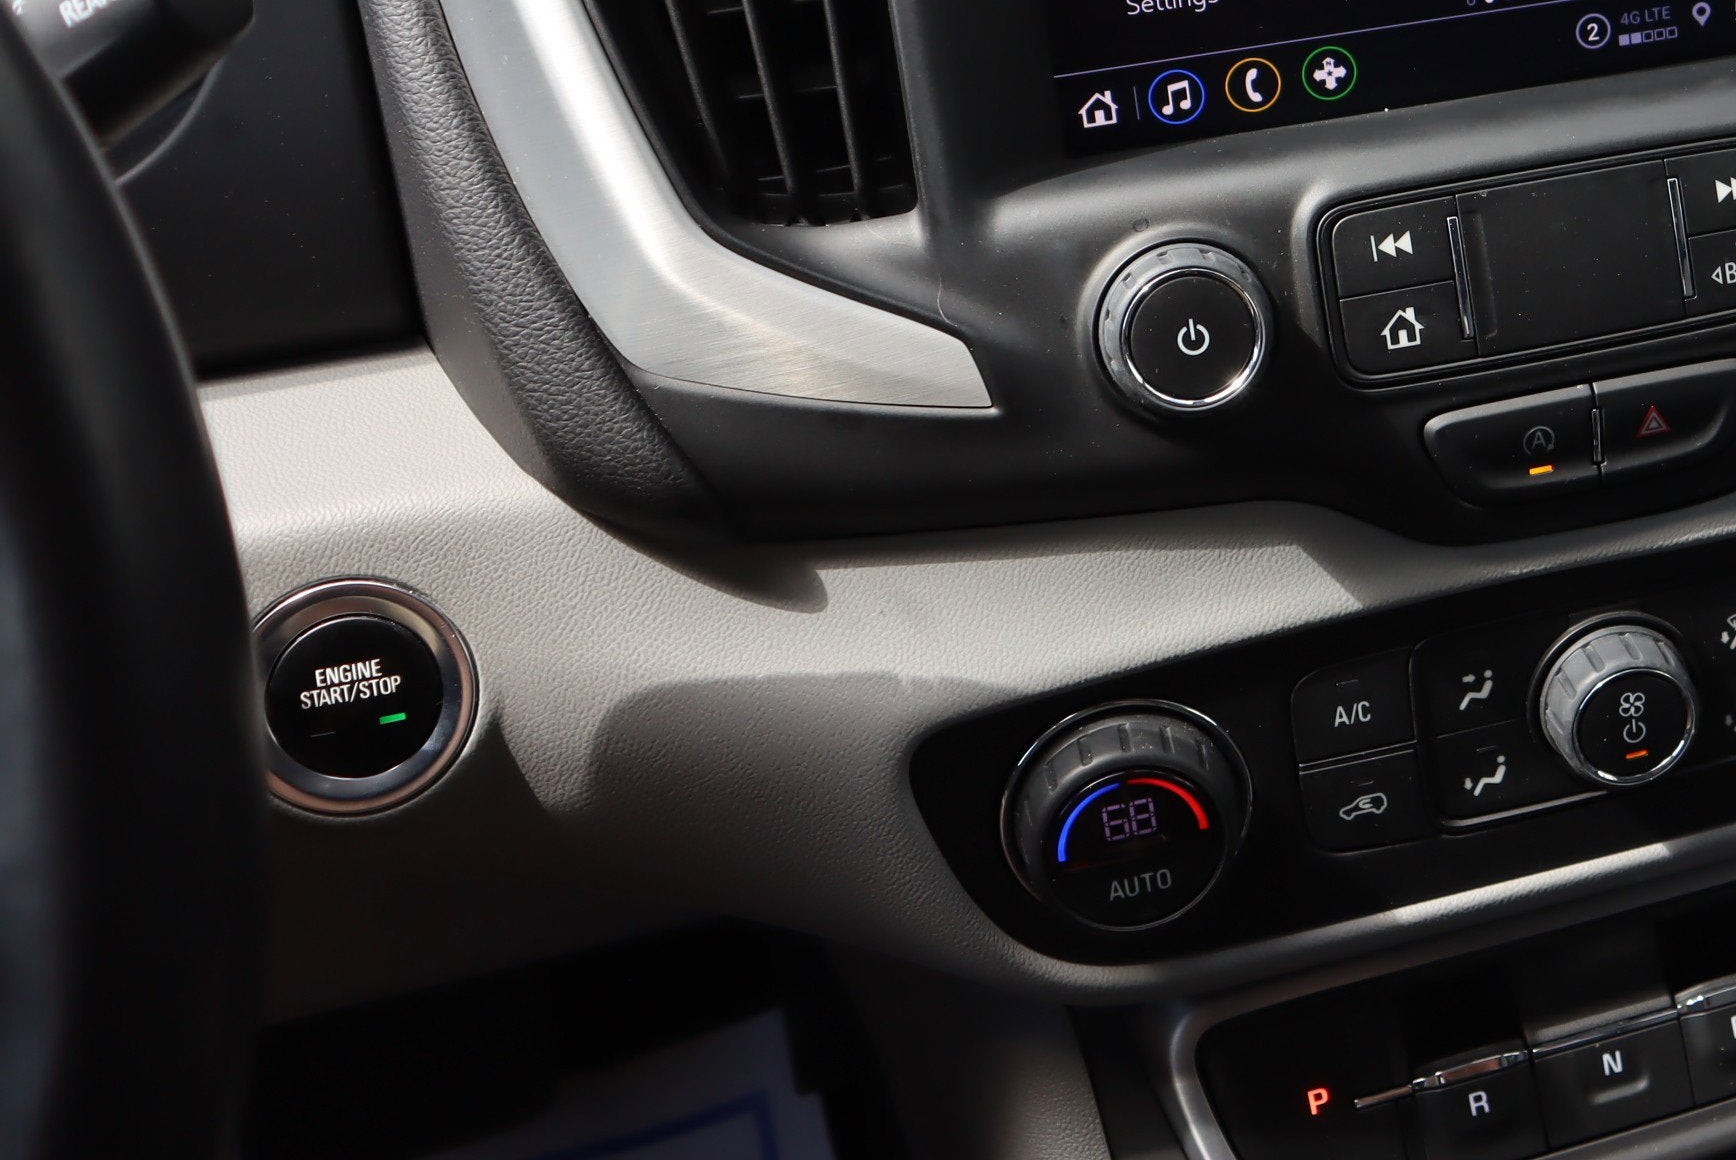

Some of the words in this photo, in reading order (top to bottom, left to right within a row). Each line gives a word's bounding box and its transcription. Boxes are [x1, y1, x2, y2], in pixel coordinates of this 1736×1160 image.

[1621, 11, 1640, 24] 4G
[1645, 6, 1670, 22] LTE
[315, 659, 382, 687] ENGINE
[300, 675, 401, 709] START/STOP
[1335, 701, 1370, 727] A/C
[1102, 797, 1156, 841] 68
[1110, 869, 1171, 901] AUTO
[1603, 1051, 1622, 1075] N
[1308, 1088, 1329, 1115] P
[1469, 1091, 1489, 1116] R
